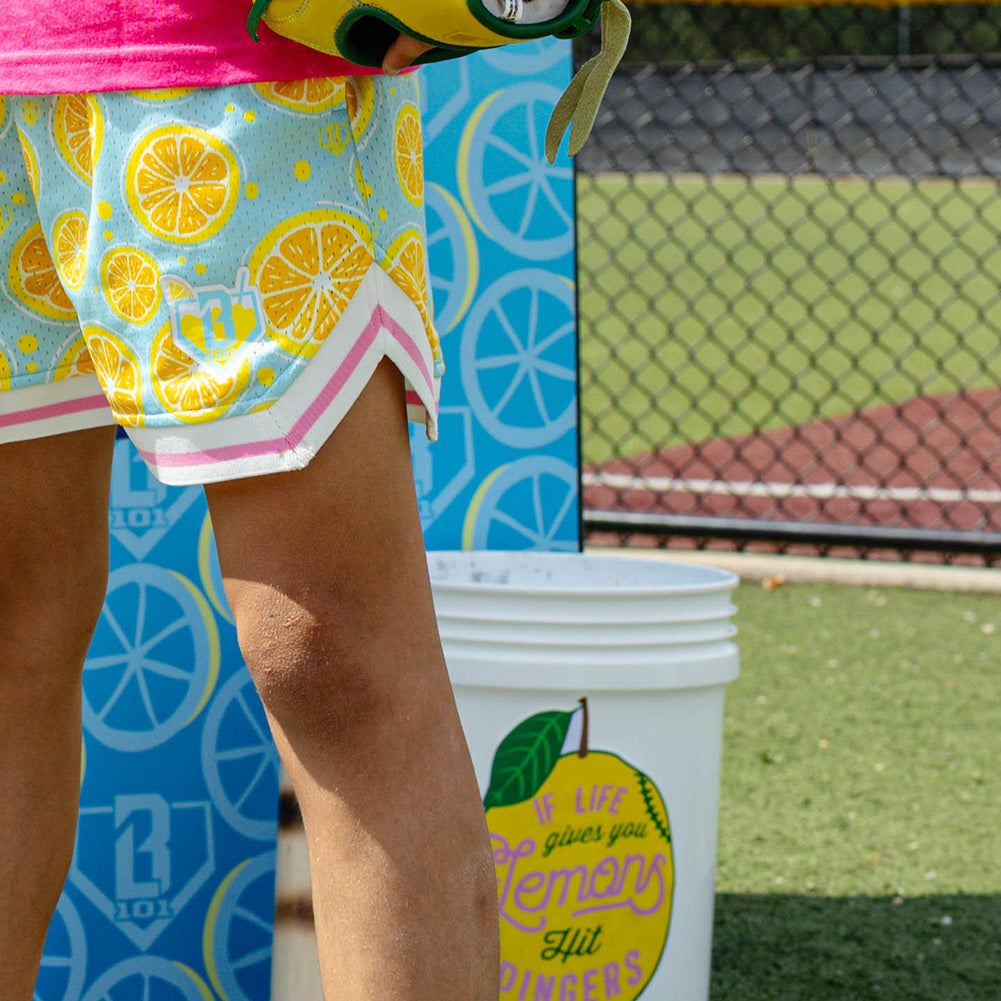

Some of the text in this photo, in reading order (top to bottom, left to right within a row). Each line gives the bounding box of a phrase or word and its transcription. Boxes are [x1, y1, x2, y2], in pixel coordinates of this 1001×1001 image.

[110, 507, 168, 529] 101
[532, 783, 628, 826] IF LIFE
[542, 820, 649, 858] gives you
[489, 832, 667, 934] Lemons
[114, 899, 174, 919] 101
[539, 924, 604, 964] Hit
[500, 948, 643, 1001] DINGERS
